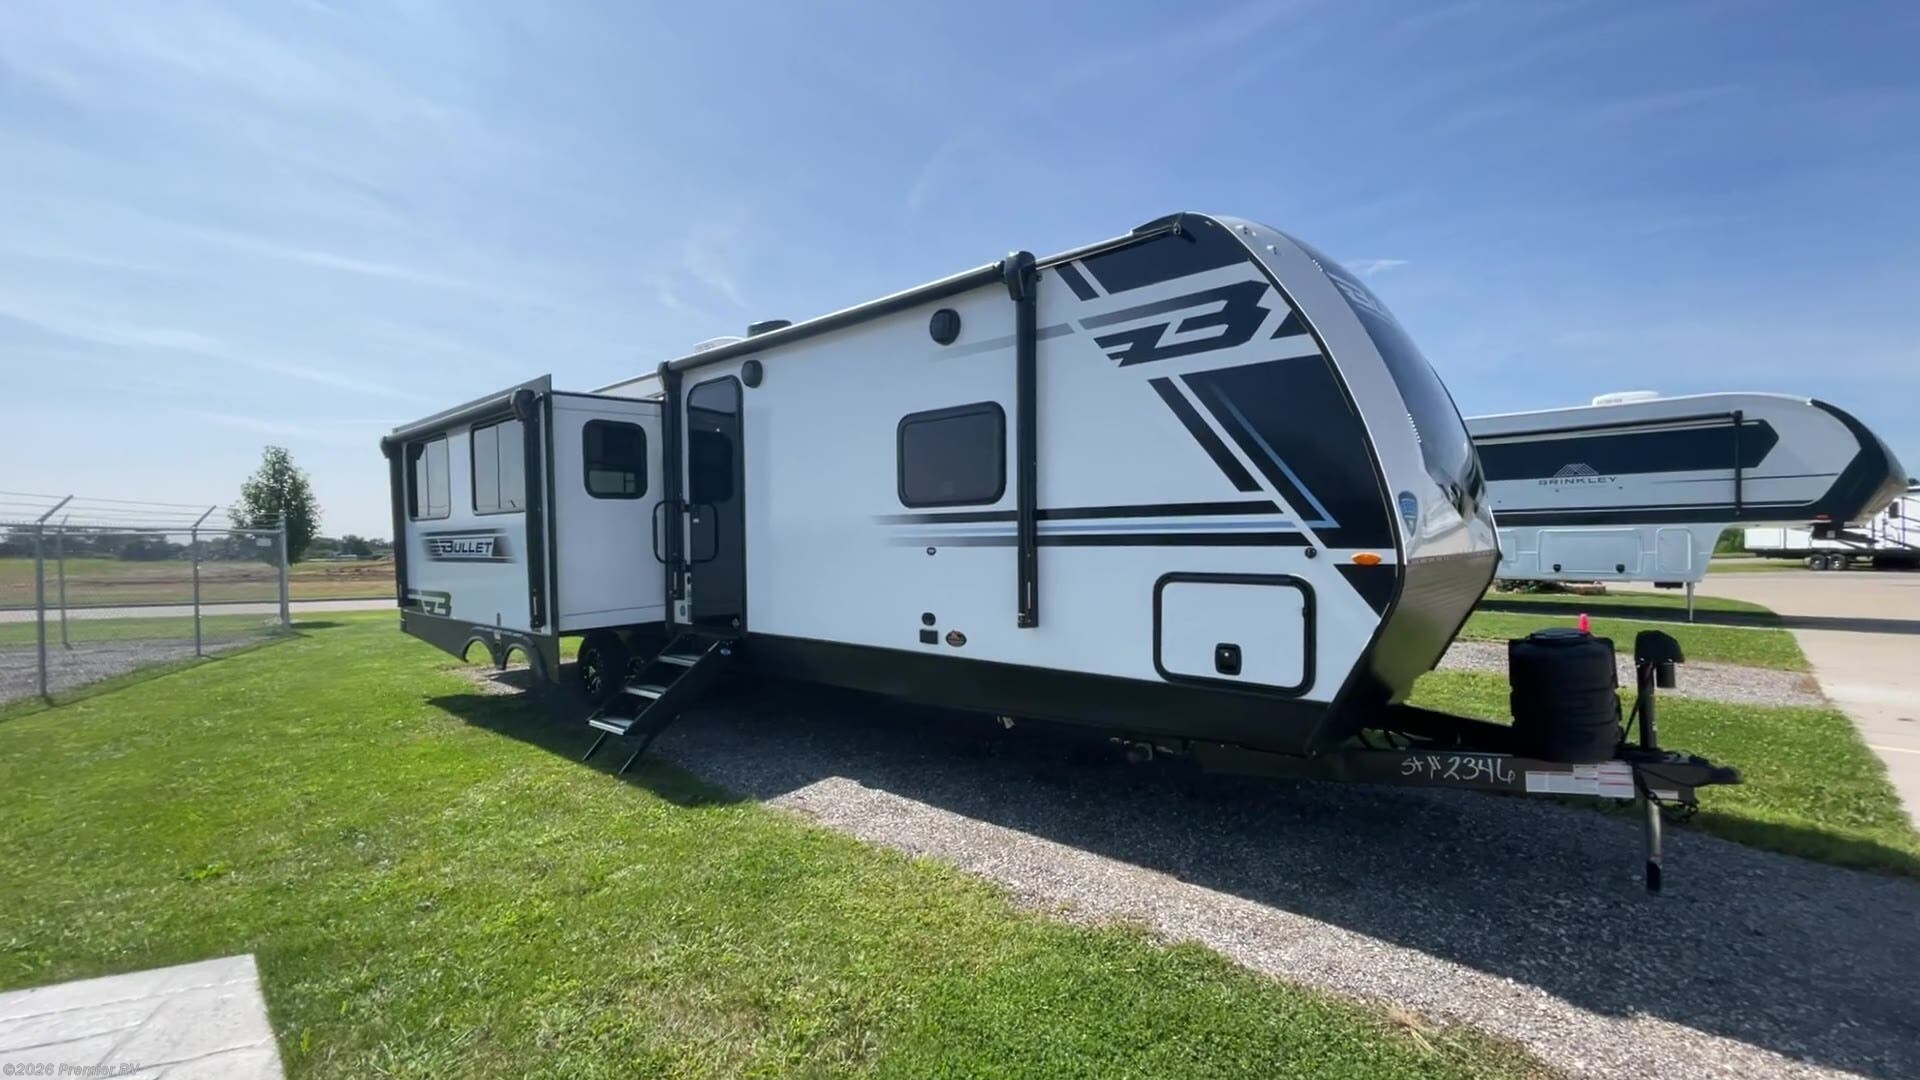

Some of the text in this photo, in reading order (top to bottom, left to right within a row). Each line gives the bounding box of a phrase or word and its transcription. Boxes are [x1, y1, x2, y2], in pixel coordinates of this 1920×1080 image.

[1538, 476, 1617, 486] BRINKLEY
[438, 540, 493, 554] BULLET
[1443, 755, 1516, 784] 2346
